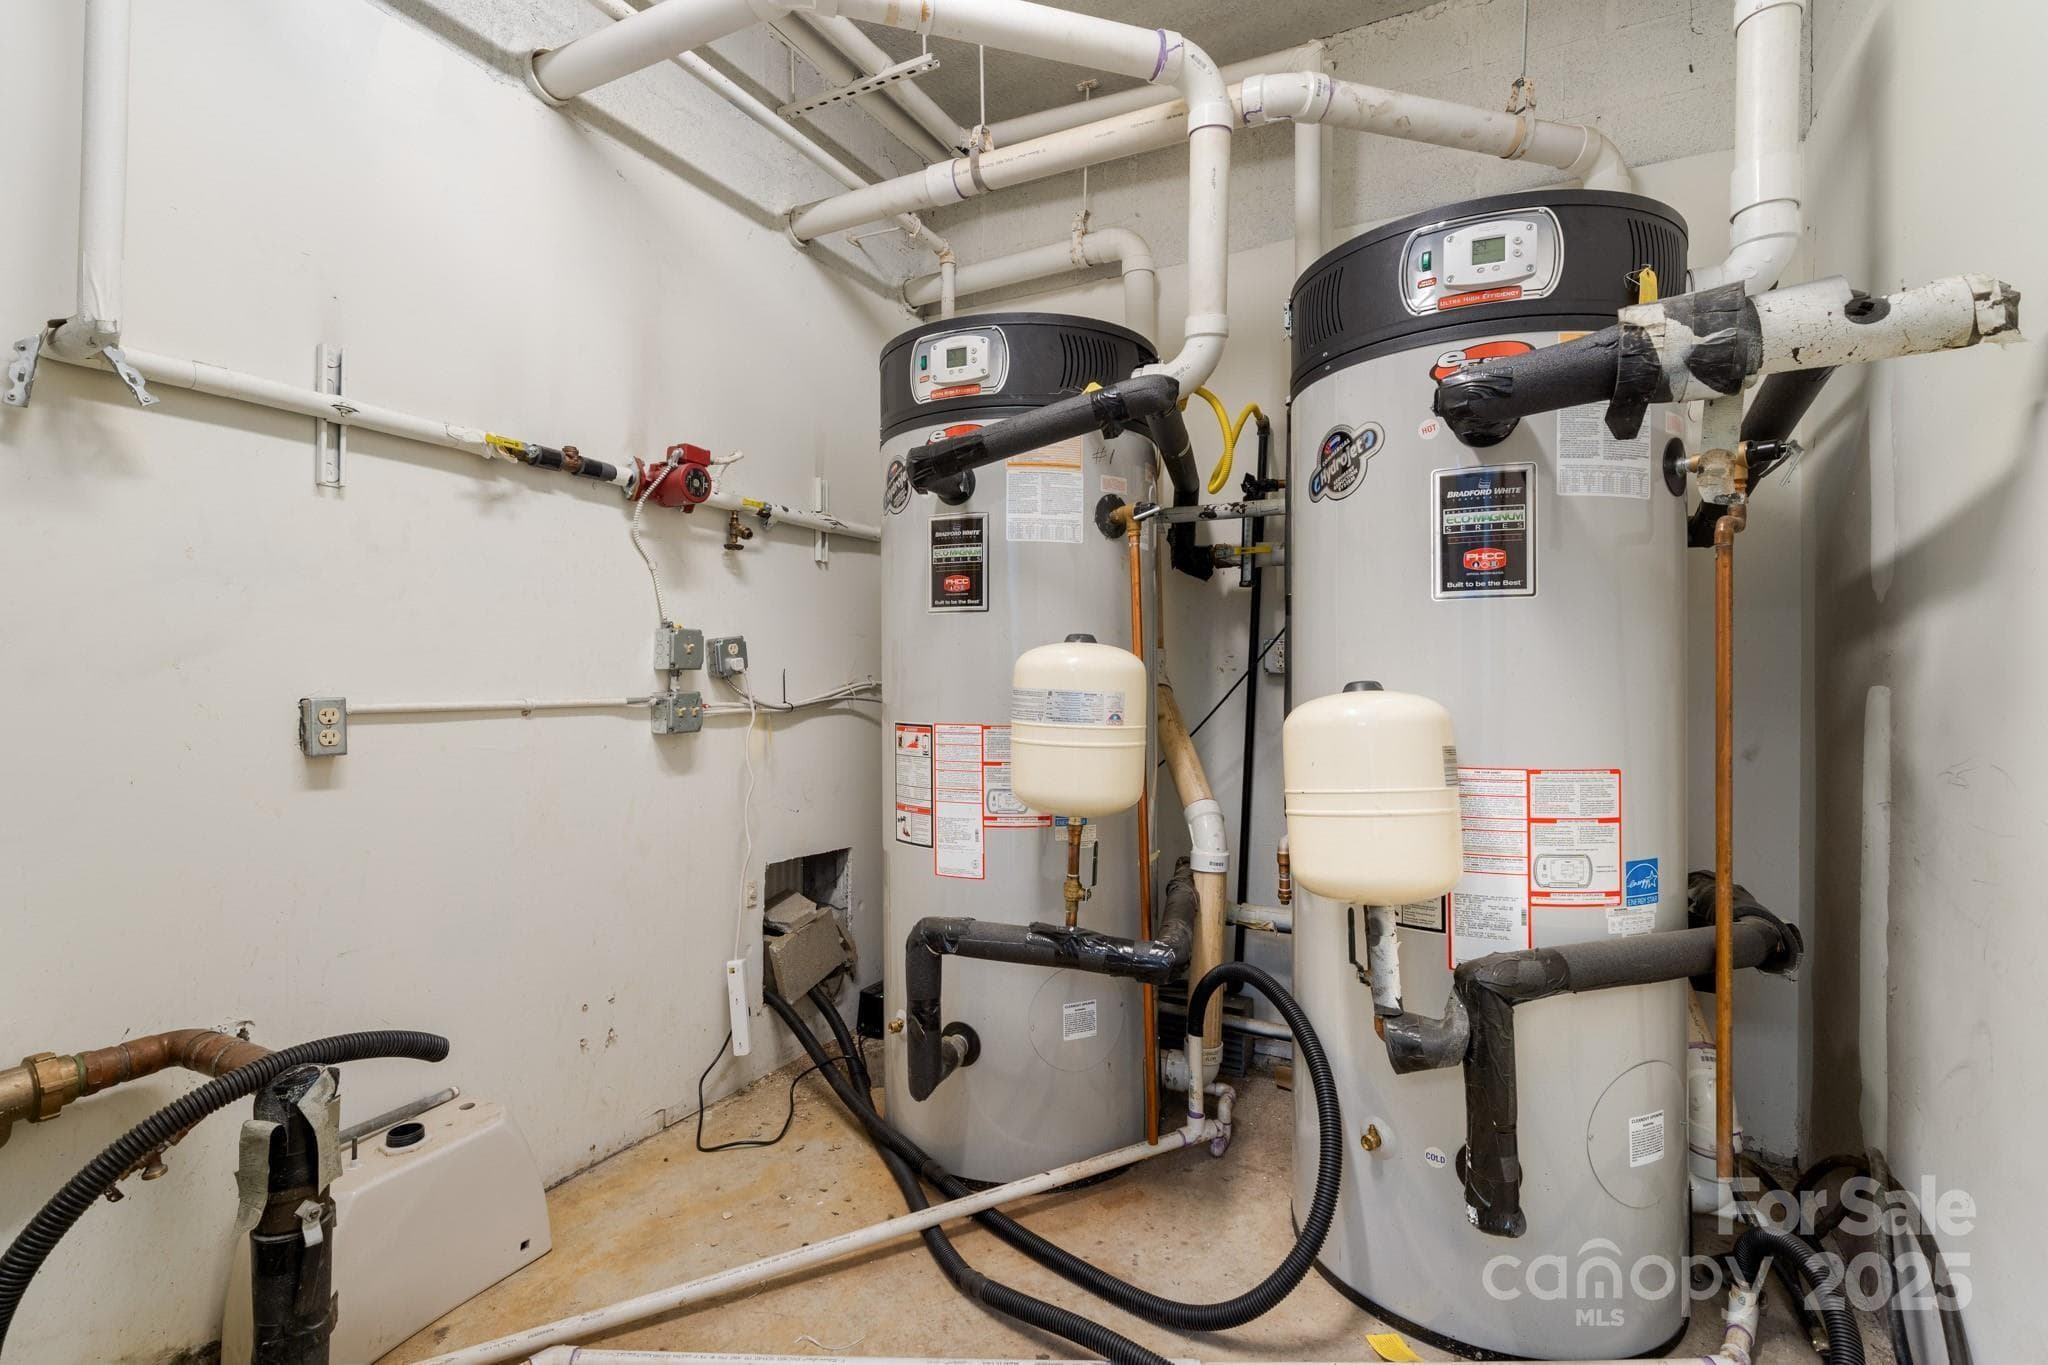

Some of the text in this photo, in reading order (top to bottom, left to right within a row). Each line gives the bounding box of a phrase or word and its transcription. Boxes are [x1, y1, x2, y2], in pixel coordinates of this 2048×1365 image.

[1421, 424, 1437, 434] HOT
[1447, 487, 1521, 498] BRADFORD WHITE
[1446, 523, 1523, 532] SERIES
[1466, 552, 1504, 561] PHCC
[1447, 580, 1464, 588] Built
[1425, 1152, 1446, 1163] COLD
